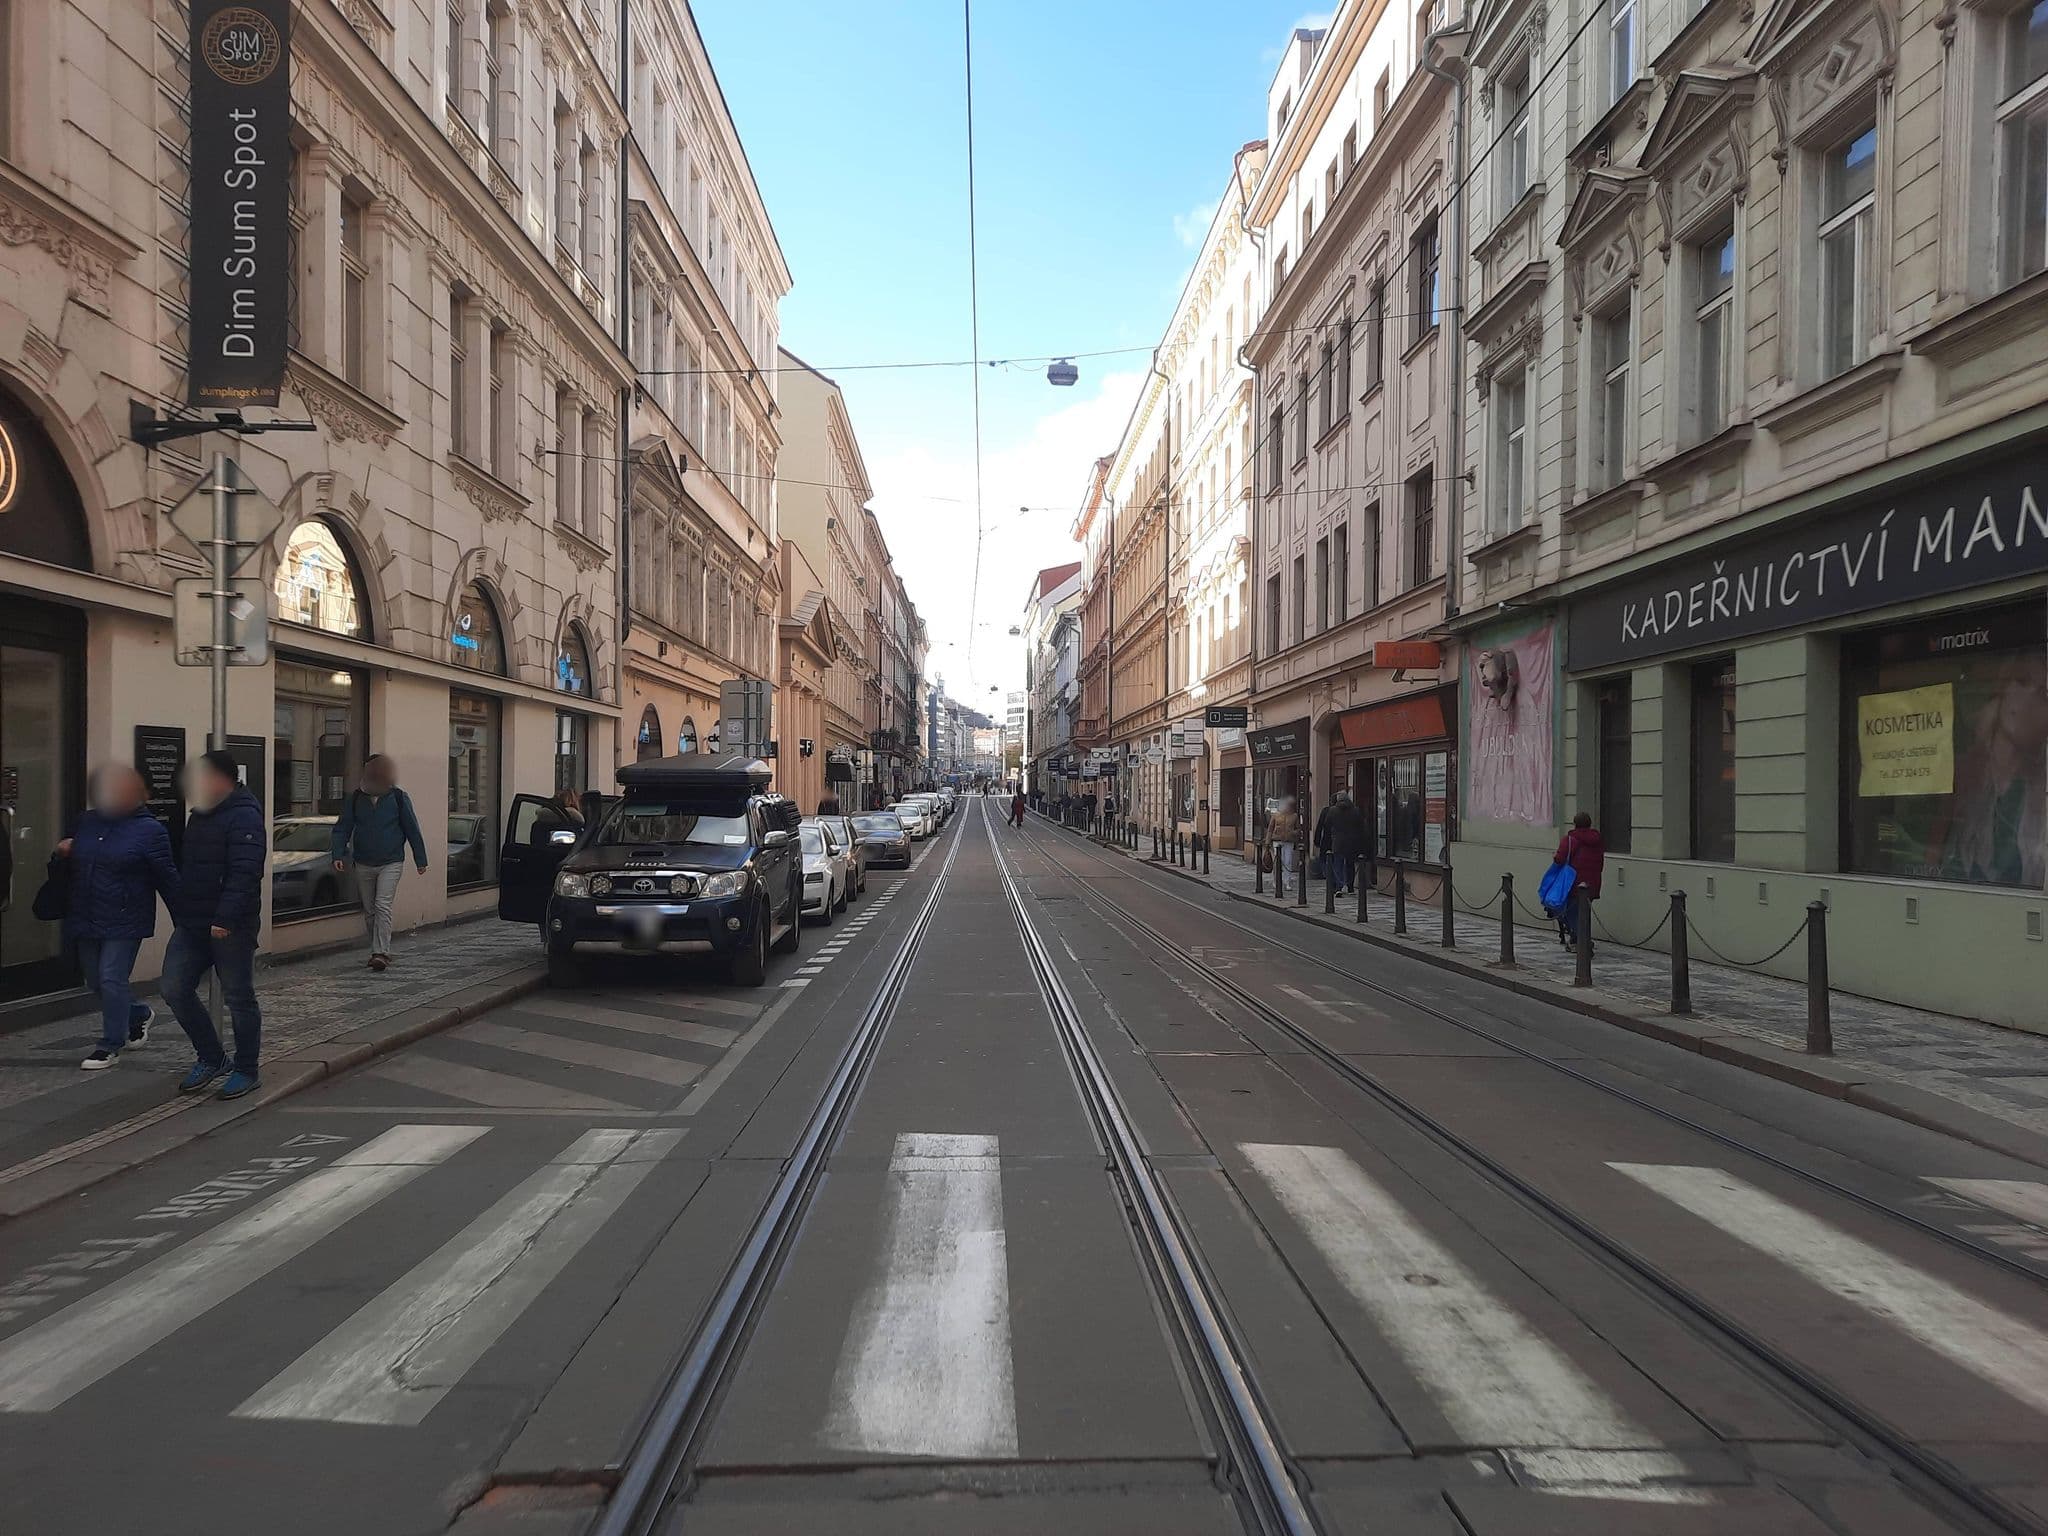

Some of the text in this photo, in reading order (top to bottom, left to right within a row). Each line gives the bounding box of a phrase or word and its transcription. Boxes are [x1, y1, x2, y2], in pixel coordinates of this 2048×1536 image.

[223, 108, 266, 358] Dim Sum Spot
[1621, 508, 1896, 643] KADEŘNICTVÍ
[1940, 627, 1990, 650] matrix
[1865, 711, 1943, 736] KOSMETIKA
